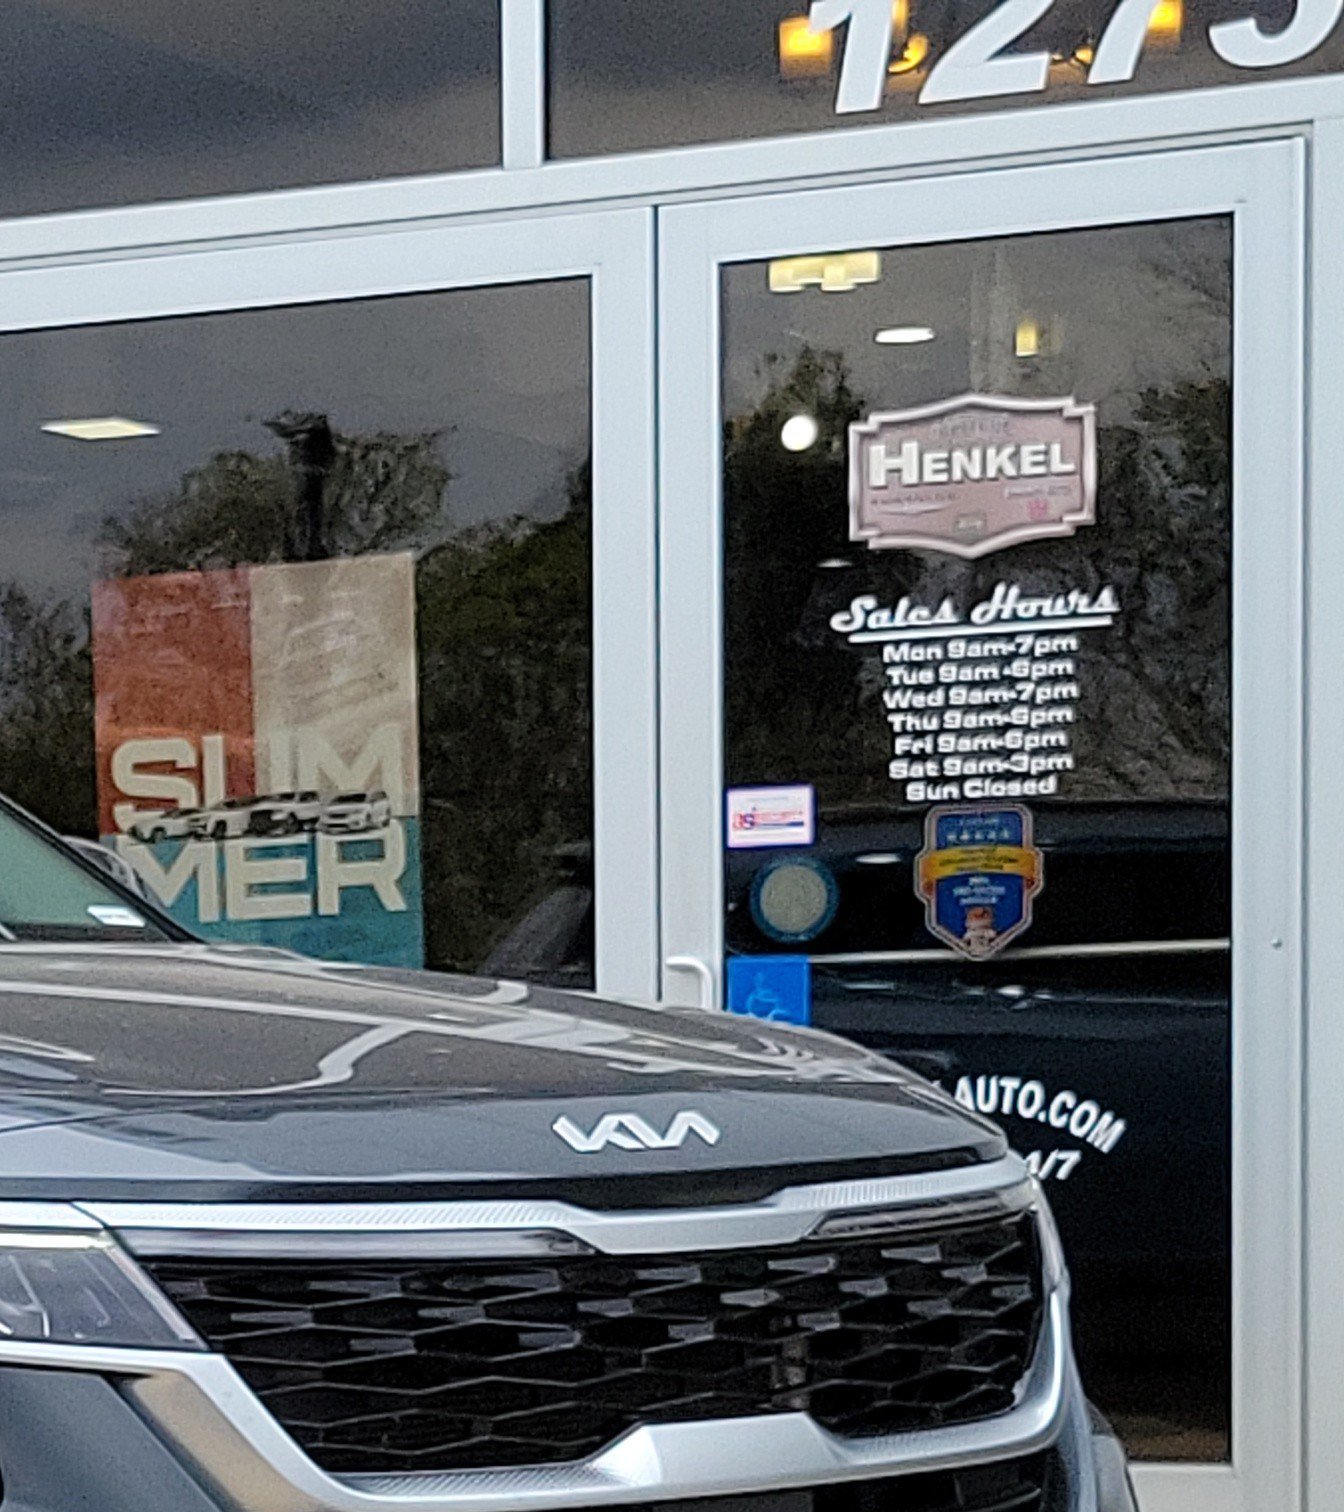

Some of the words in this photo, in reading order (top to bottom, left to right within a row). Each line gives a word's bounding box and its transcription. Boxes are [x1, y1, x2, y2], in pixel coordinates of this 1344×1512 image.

[868, 440, 1078, 488] HENKEL
[829, 595, 959, 632] Sales
[969, 581, 1122, 624] Hours
[883, 642, 943, 663] Mon
[948, 634, 1079, 659] 9am-7pm
[886, 665, 935, 686] Tue
[883, 686, 946, 709] Wed
[949, 681, 1080, 704] 9am-7pm
[887, 712, 940, 733] Thu
[895, 734, 934, 756] Fri
[888, 758, 941, 780] Sat
[905, 781, 961, 802] Sun
[963, 774, 1058, 799] Closed
[948, 1074, 1128, 1155] AUTO.COM
